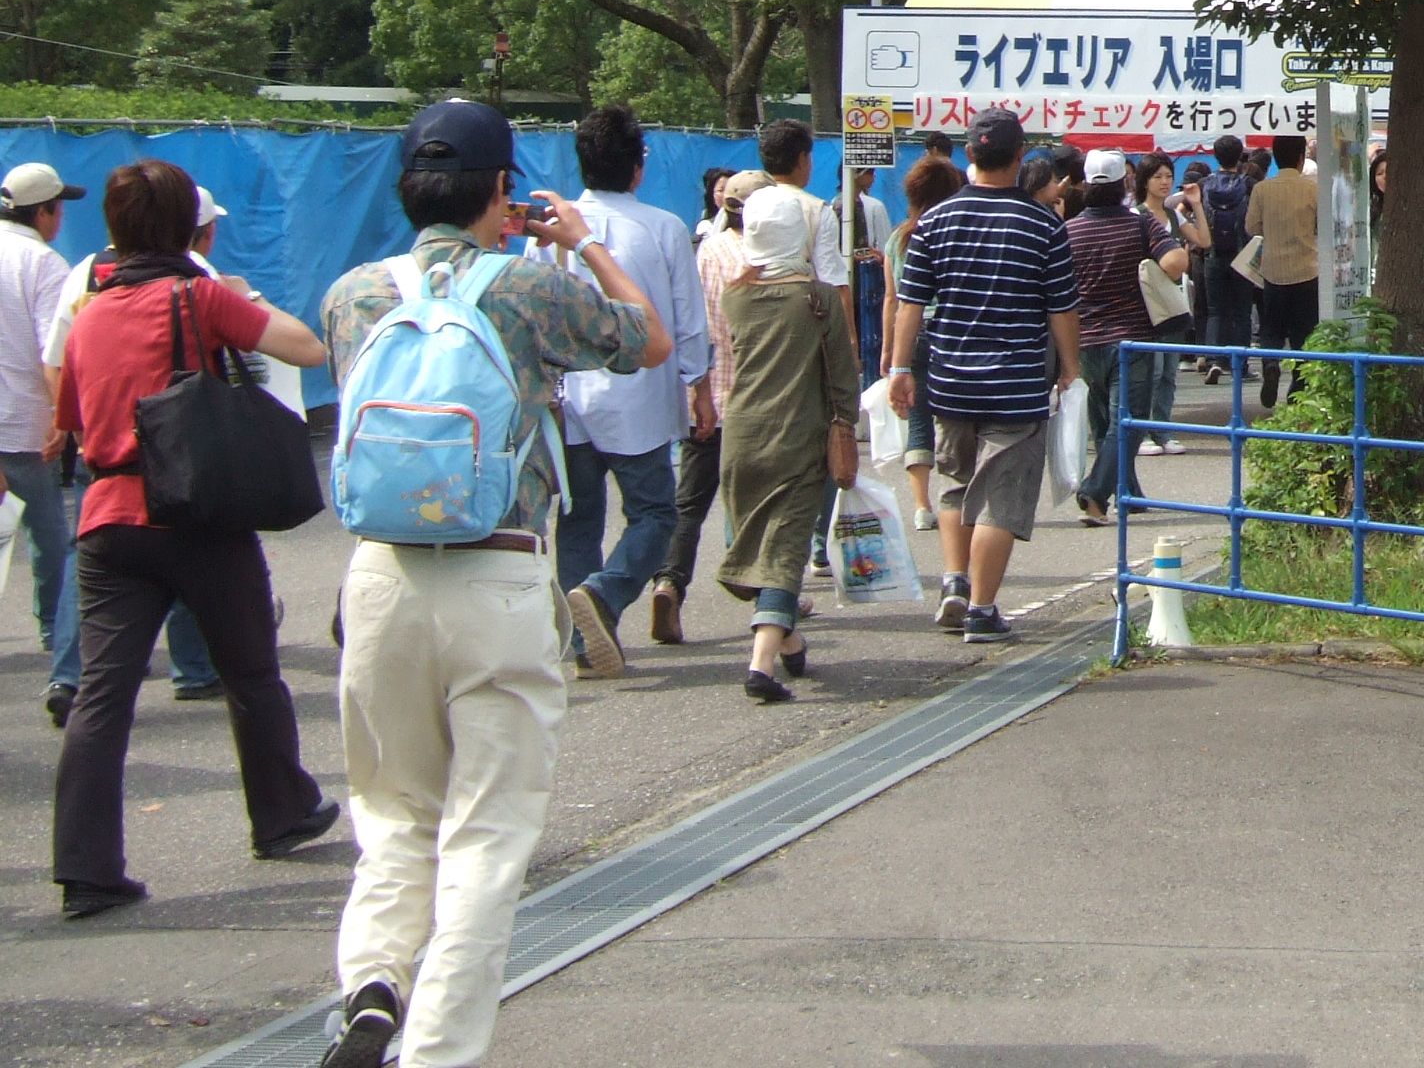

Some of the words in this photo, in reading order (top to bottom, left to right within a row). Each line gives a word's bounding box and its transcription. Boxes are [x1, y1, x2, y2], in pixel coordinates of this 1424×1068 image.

[954, 32, 1132, 88] ライブエリア
[1153, 34, 1244, 90] 入場口
